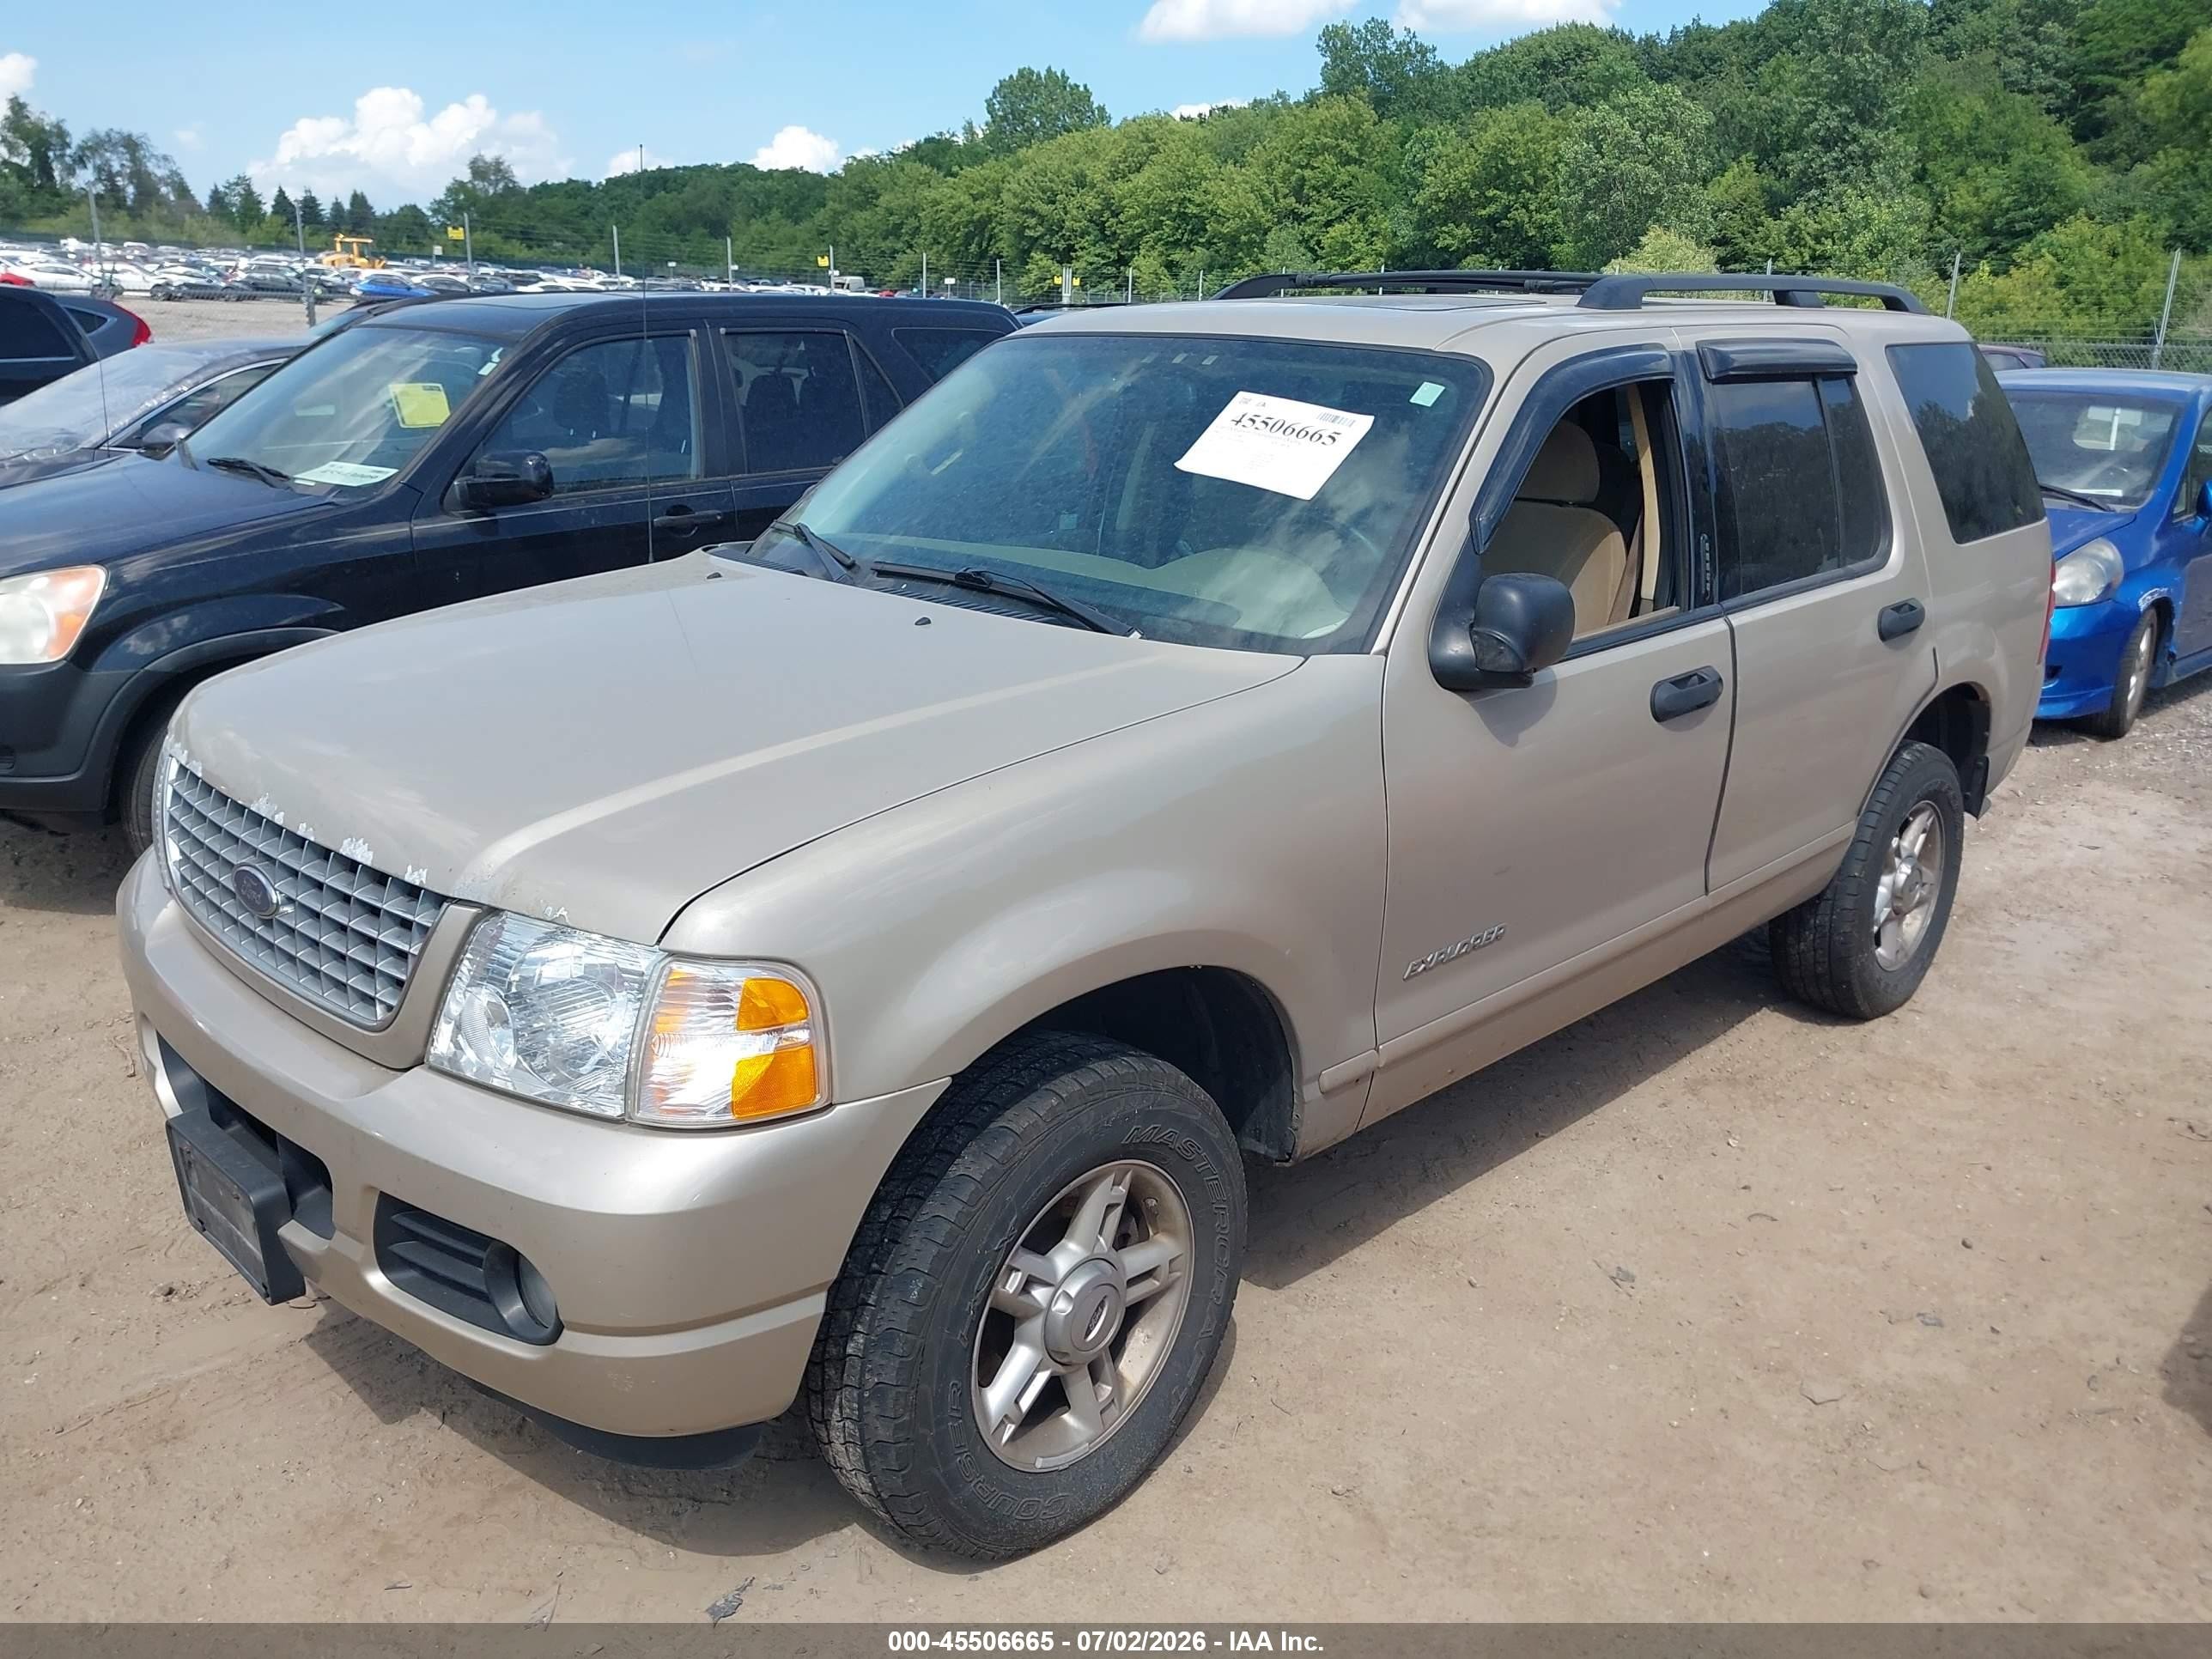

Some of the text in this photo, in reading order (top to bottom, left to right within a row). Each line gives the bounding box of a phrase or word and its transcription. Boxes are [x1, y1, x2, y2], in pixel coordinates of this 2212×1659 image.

[1231, 411, 1342, 447] 45506665
[1402, 922, 1507, 981] EXPLORER
[947, 1379, 1073, 1521] COURSER
